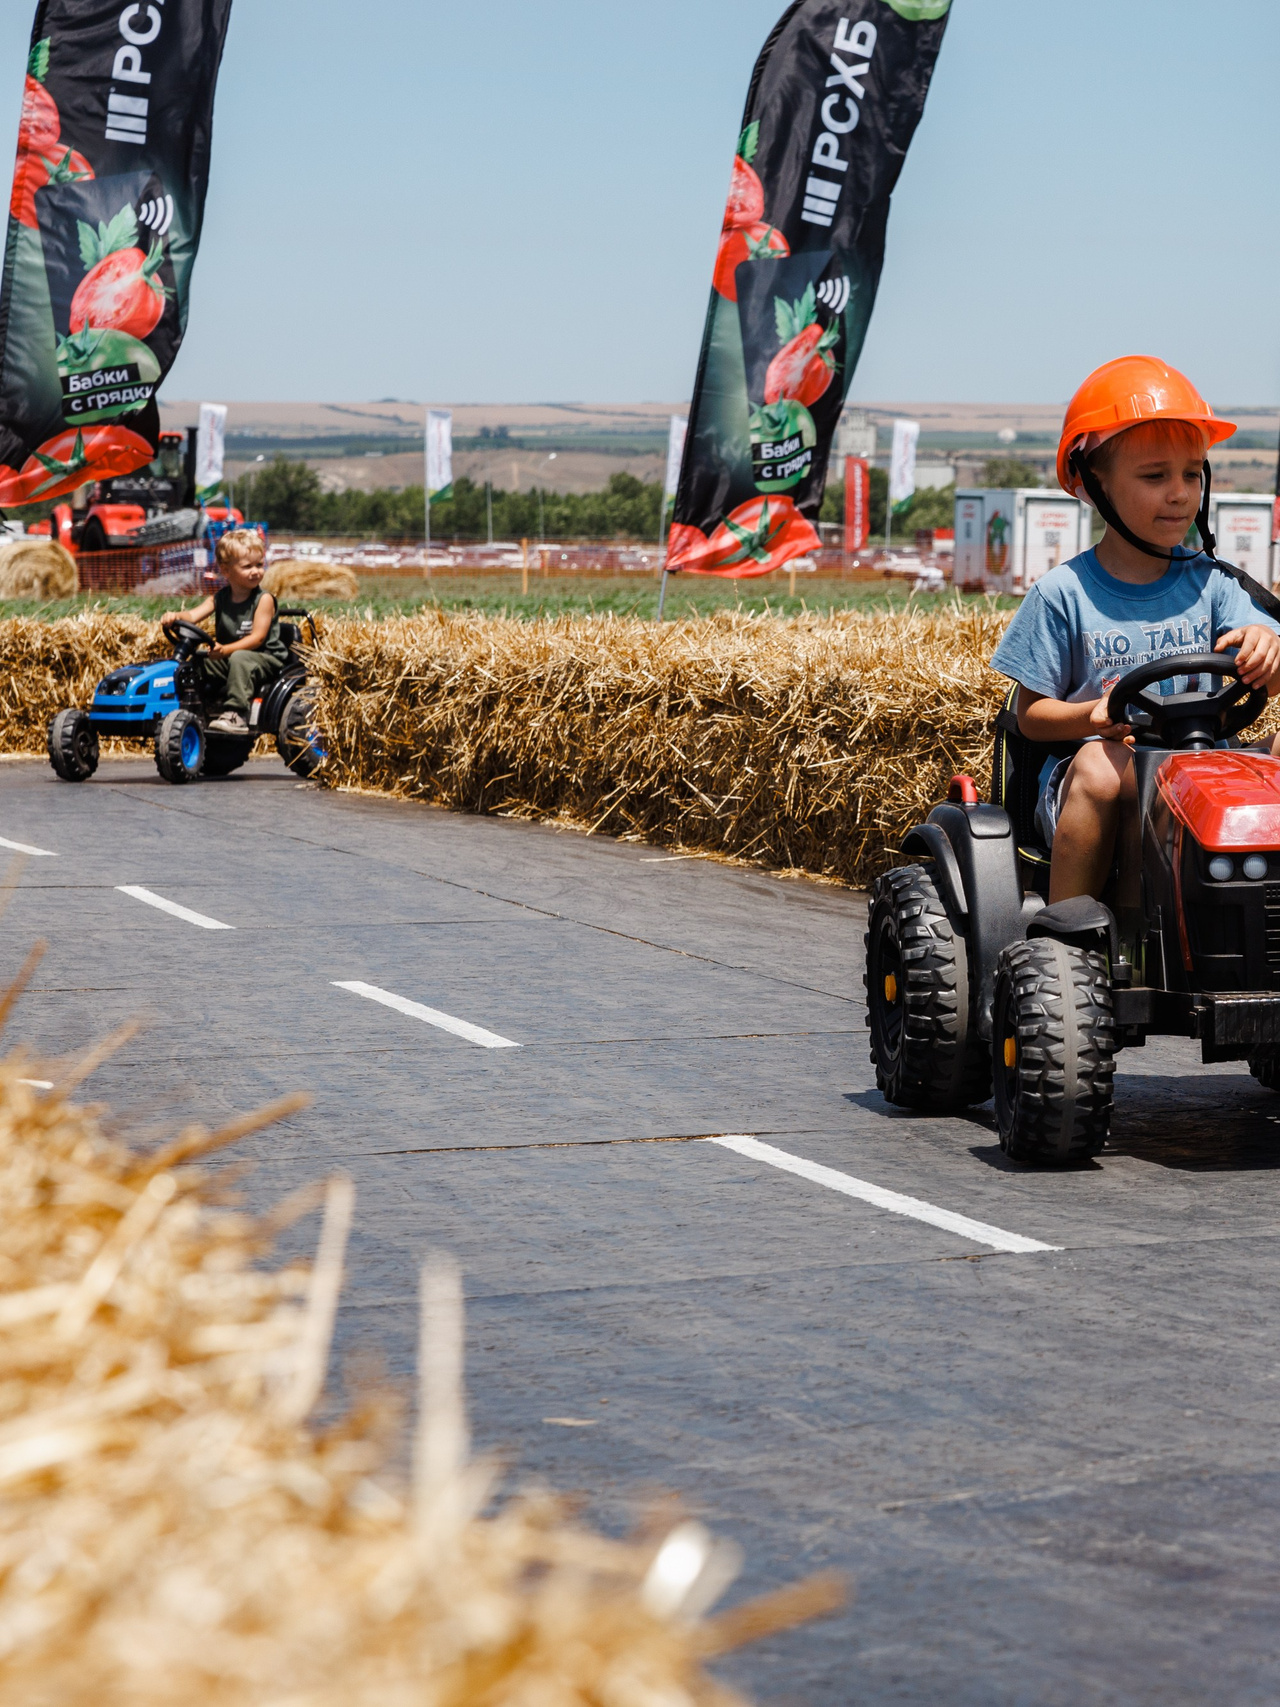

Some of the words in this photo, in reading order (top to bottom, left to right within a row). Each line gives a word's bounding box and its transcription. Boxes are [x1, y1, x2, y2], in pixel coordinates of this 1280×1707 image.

[112, 0, 165, 84] РС
[812, 17, 878, 172] РСХБ
[69, 369, 129, 392] Бабки
[71, 399, 83, 412] с
[761, 465, 773, 478] с
[1083, 629, 1132, 658] NO
[1140, 616, 1210, 651] TALK
[1095, 655, 1136, 668] WHEN
